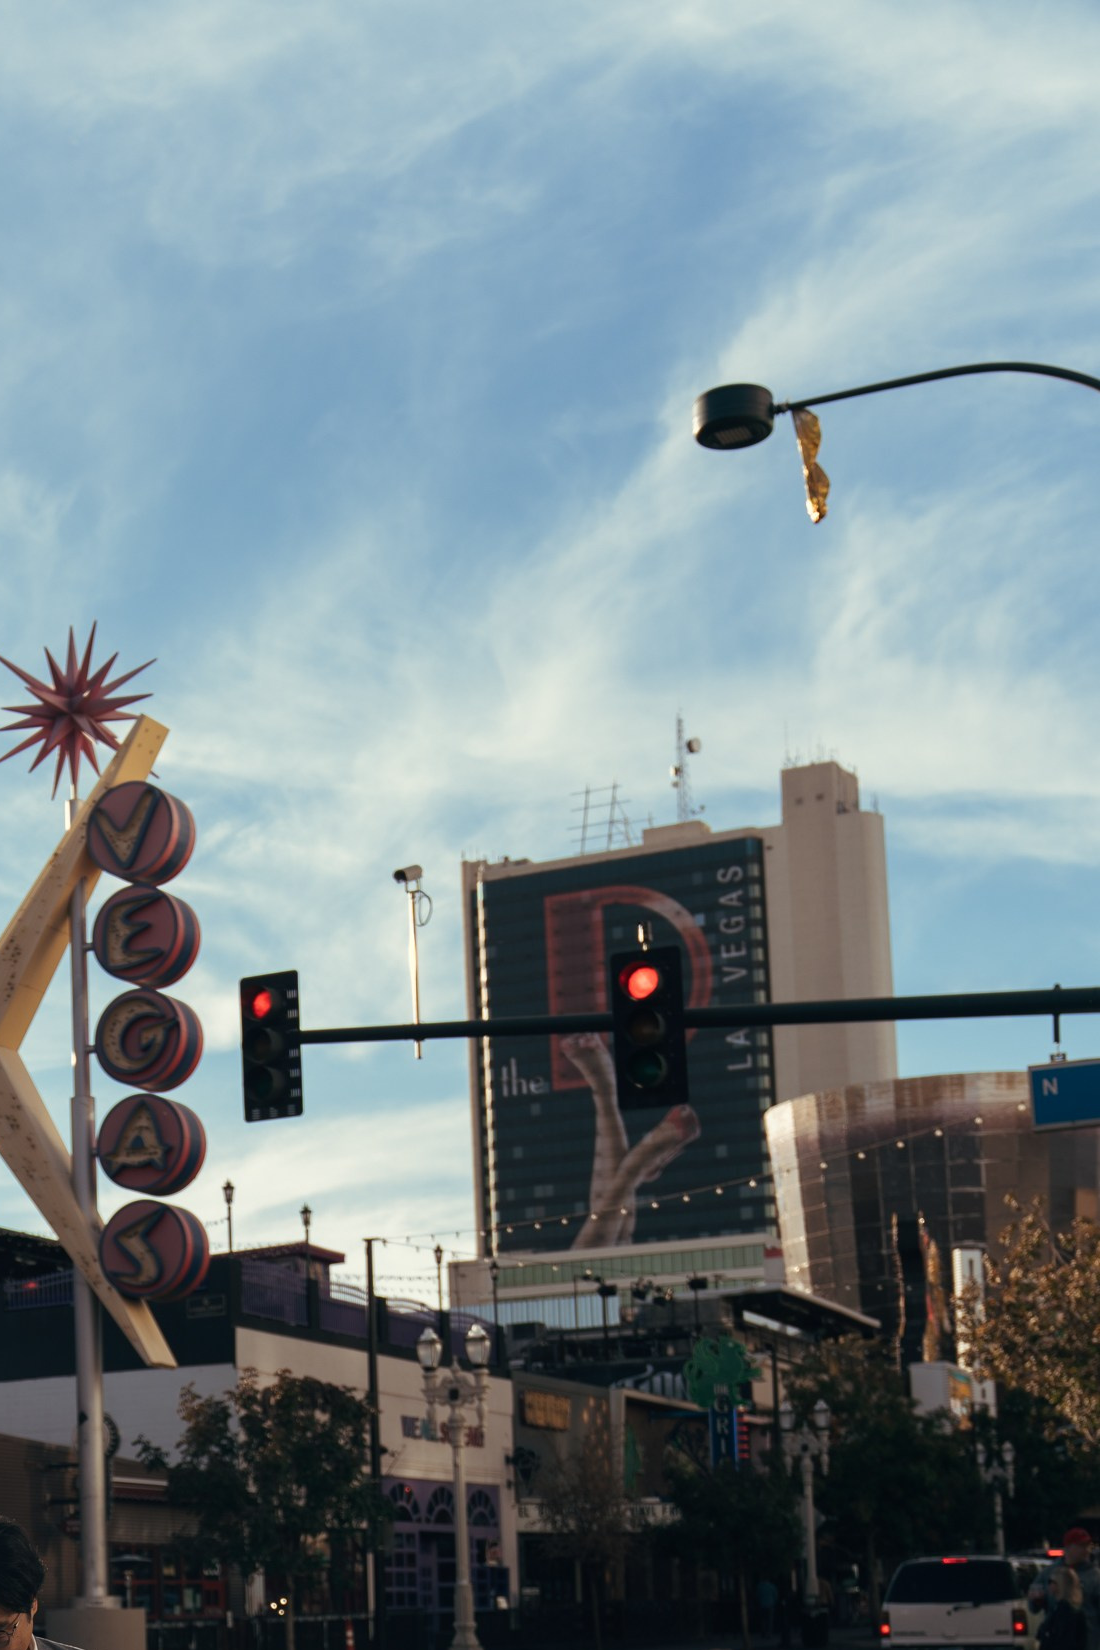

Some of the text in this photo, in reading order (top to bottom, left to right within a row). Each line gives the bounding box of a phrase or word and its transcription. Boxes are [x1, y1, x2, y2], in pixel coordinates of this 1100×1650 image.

[716, 865, 747, 983] VEGAS
[93, 786, 180, 1290] VEGAS
[501, 1057, 544, 1096] the
[1042, 1077, 1059, 1096] N
[713, 1396, 730, 1465] GRI
